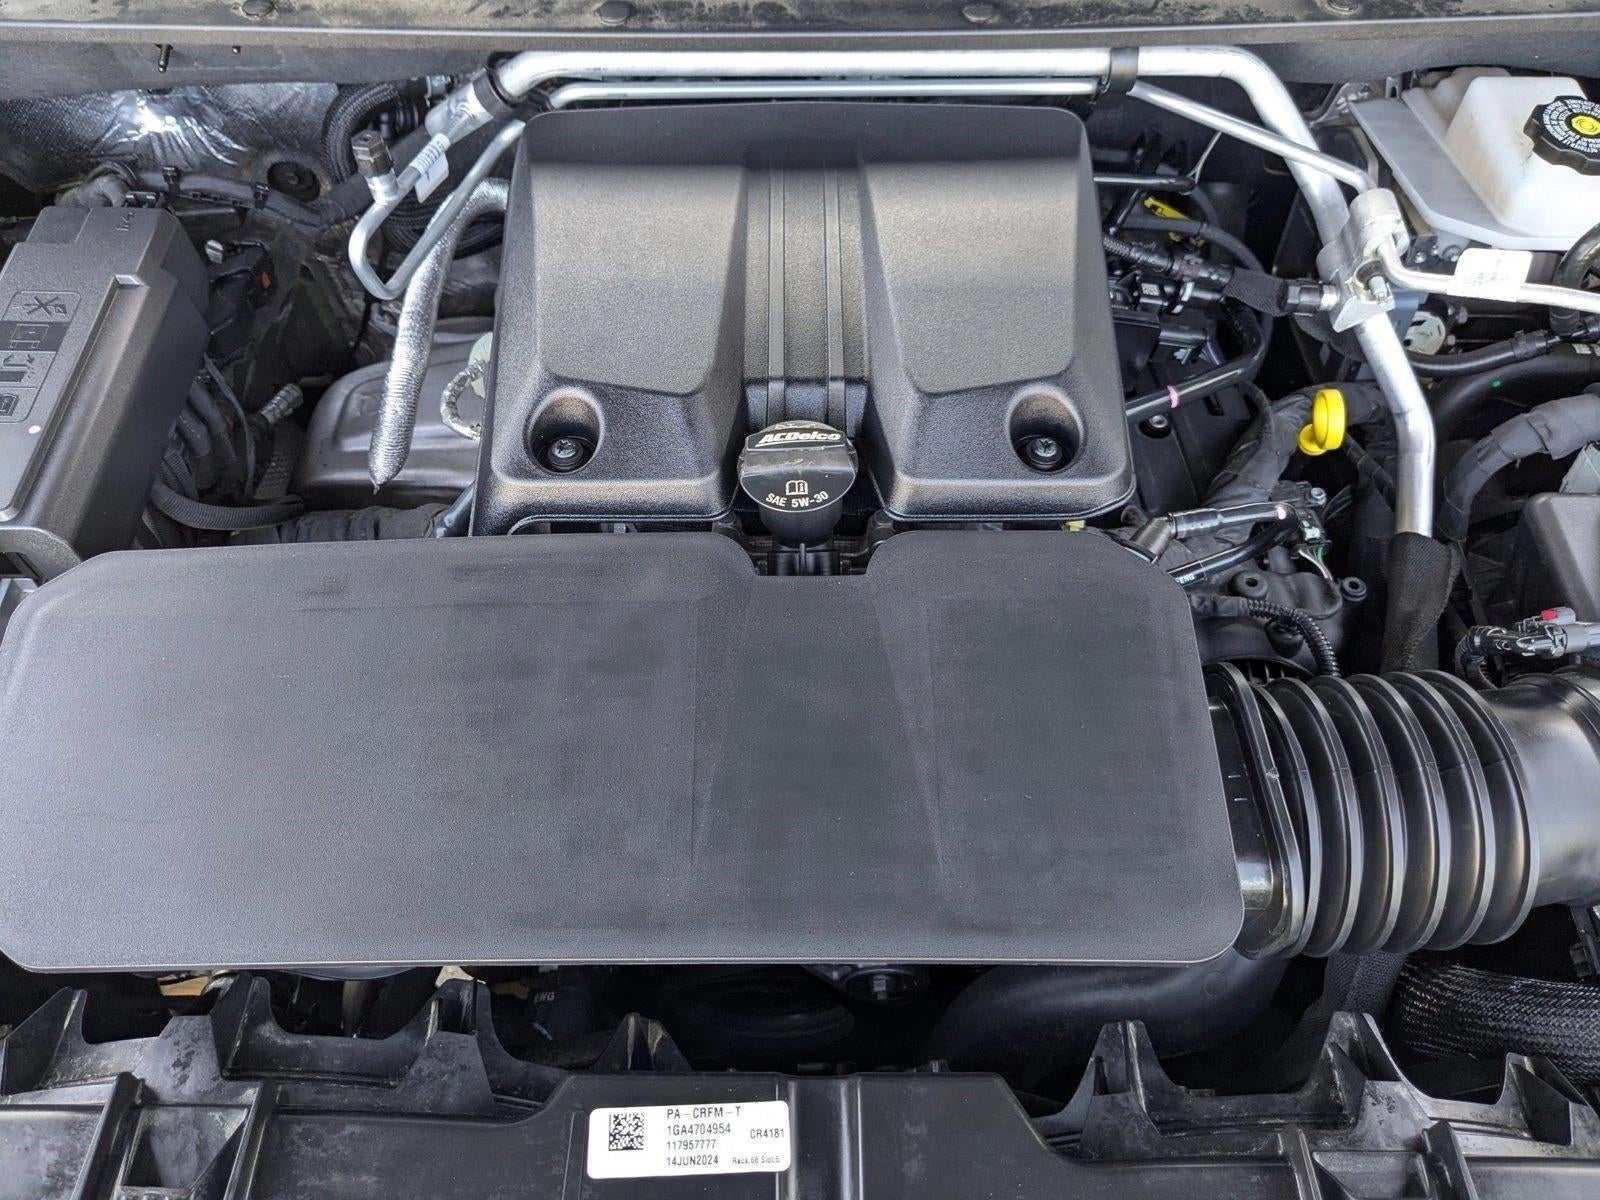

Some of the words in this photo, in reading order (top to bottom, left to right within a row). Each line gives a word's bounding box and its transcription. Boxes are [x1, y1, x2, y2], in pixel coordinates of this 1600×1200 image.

[759, 431, 841, 444] ACDelco
[765, 493, 787, 507] SAE
[791, 490, 829, 508] 5W-30
[667, 1123, 731, 1136] 1GA4704954
[750, 1128, 785, 1139] CR4181
[667, 1139, 716, 1150] 117957777
[667, 1154, 719, 1166] 14JUN2024
